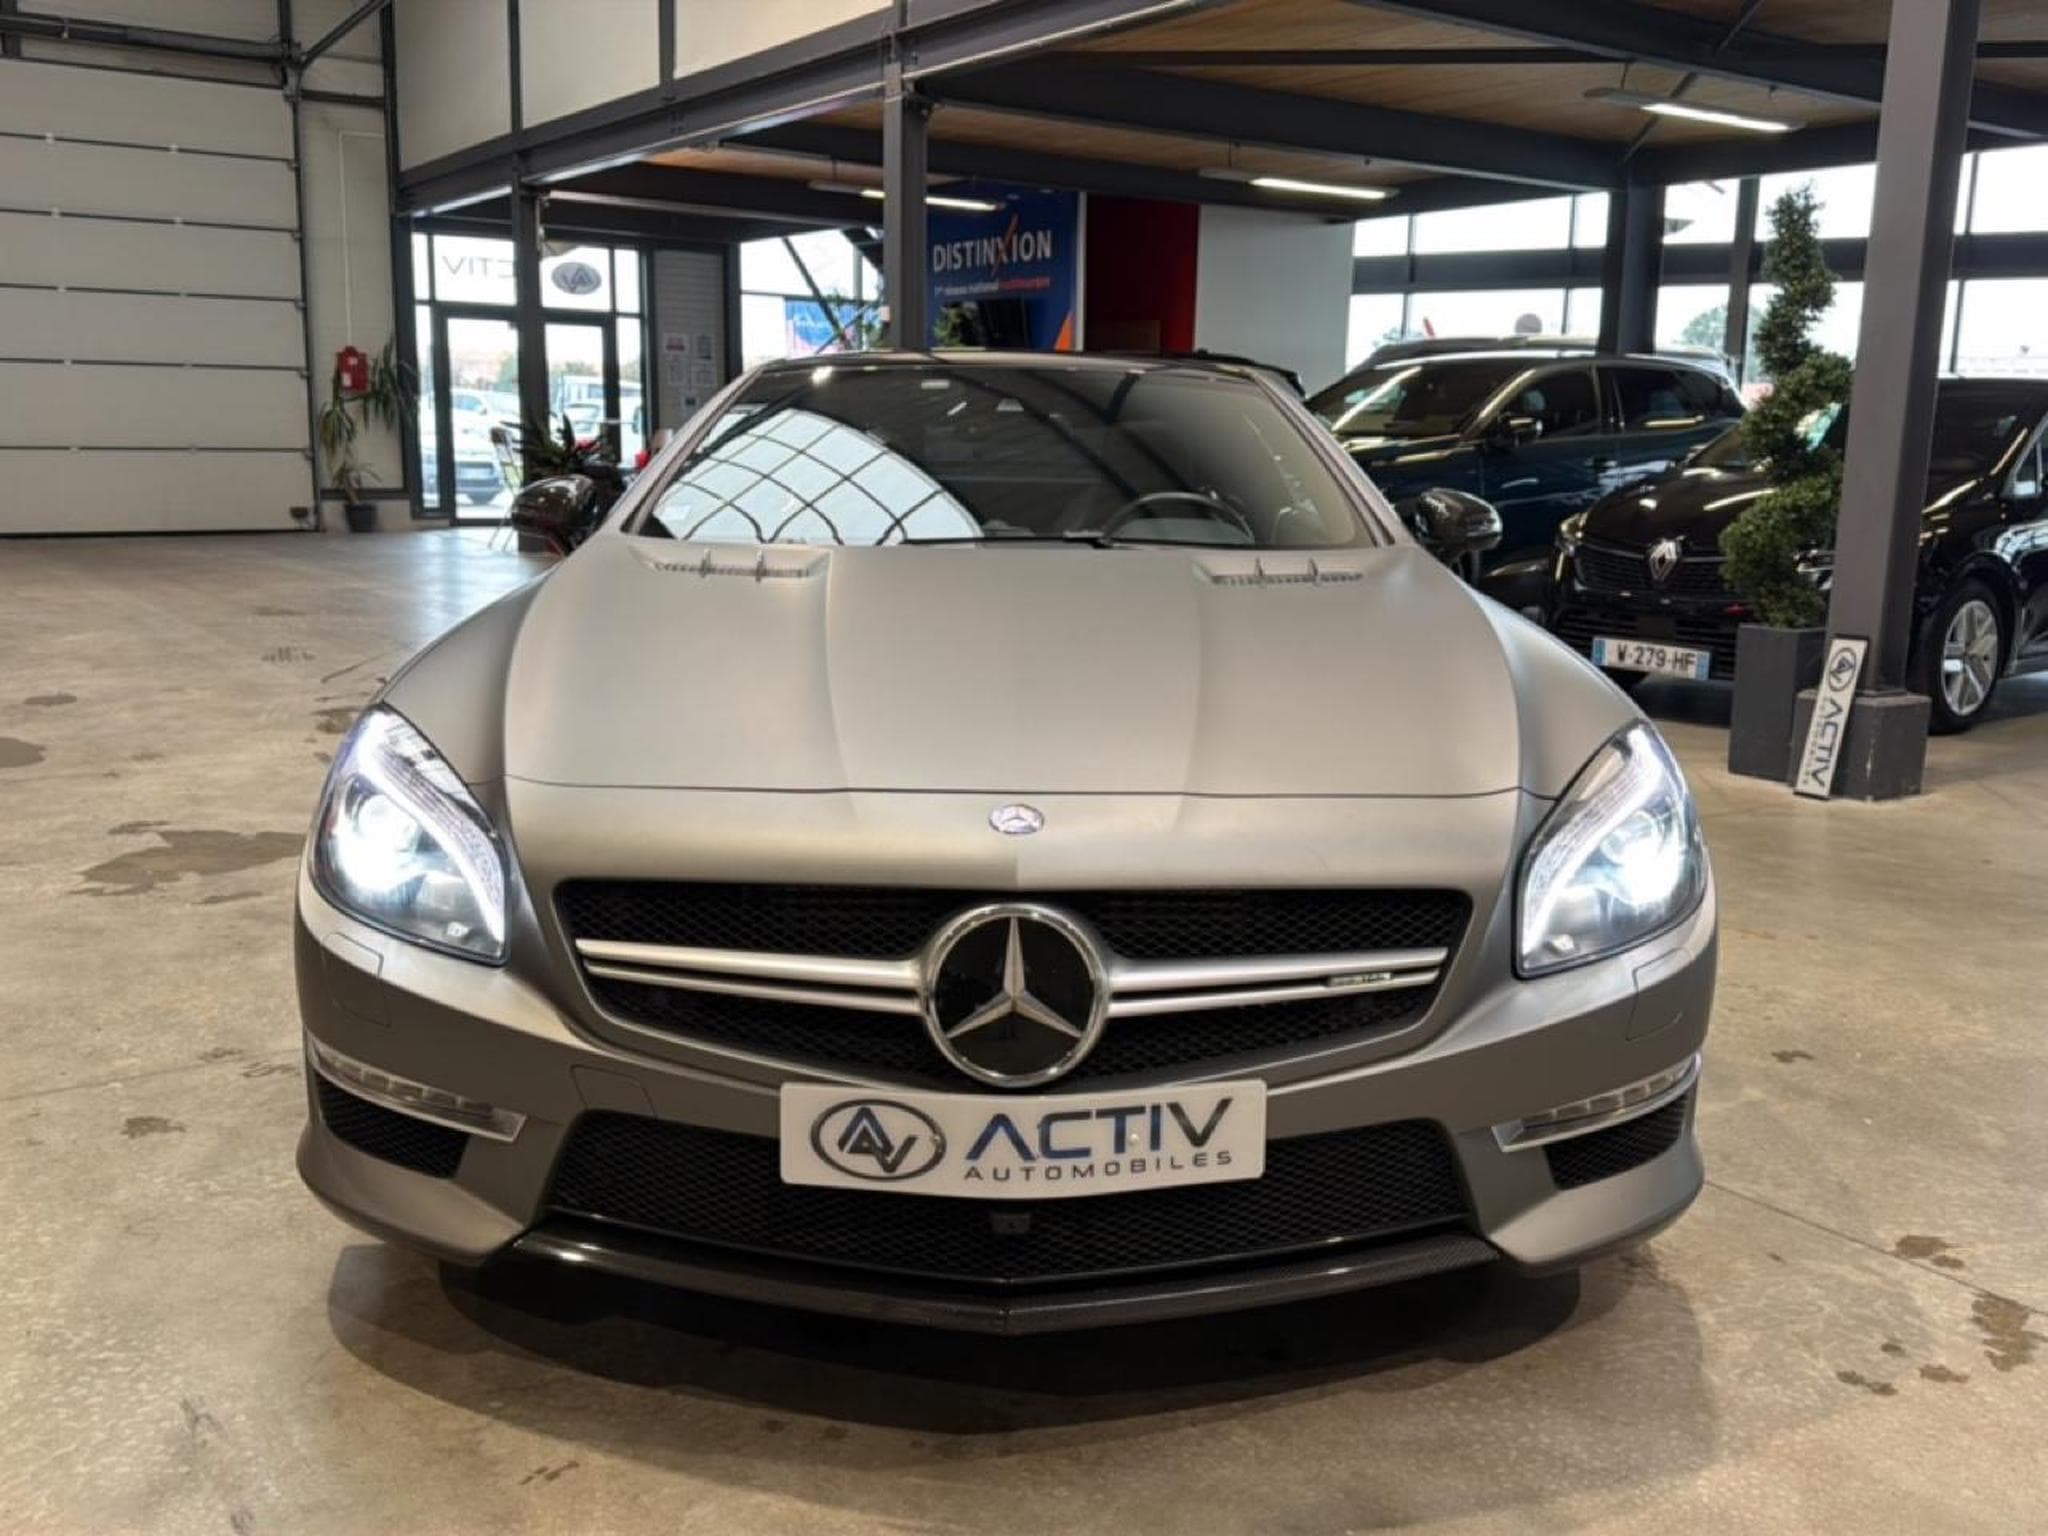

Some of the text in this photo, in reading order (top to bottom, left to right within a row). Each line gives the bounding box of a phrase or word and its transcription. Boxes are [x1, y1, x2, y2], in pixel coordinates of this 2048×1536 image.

[933, 215, 1052, 276] DISTINXION
[1811, 698, 1843, 786] ACTIV
[965, 1098, 1233, 1161] ACTIV
[964, 1150, 1232, 1181] AUTOMOBILES
